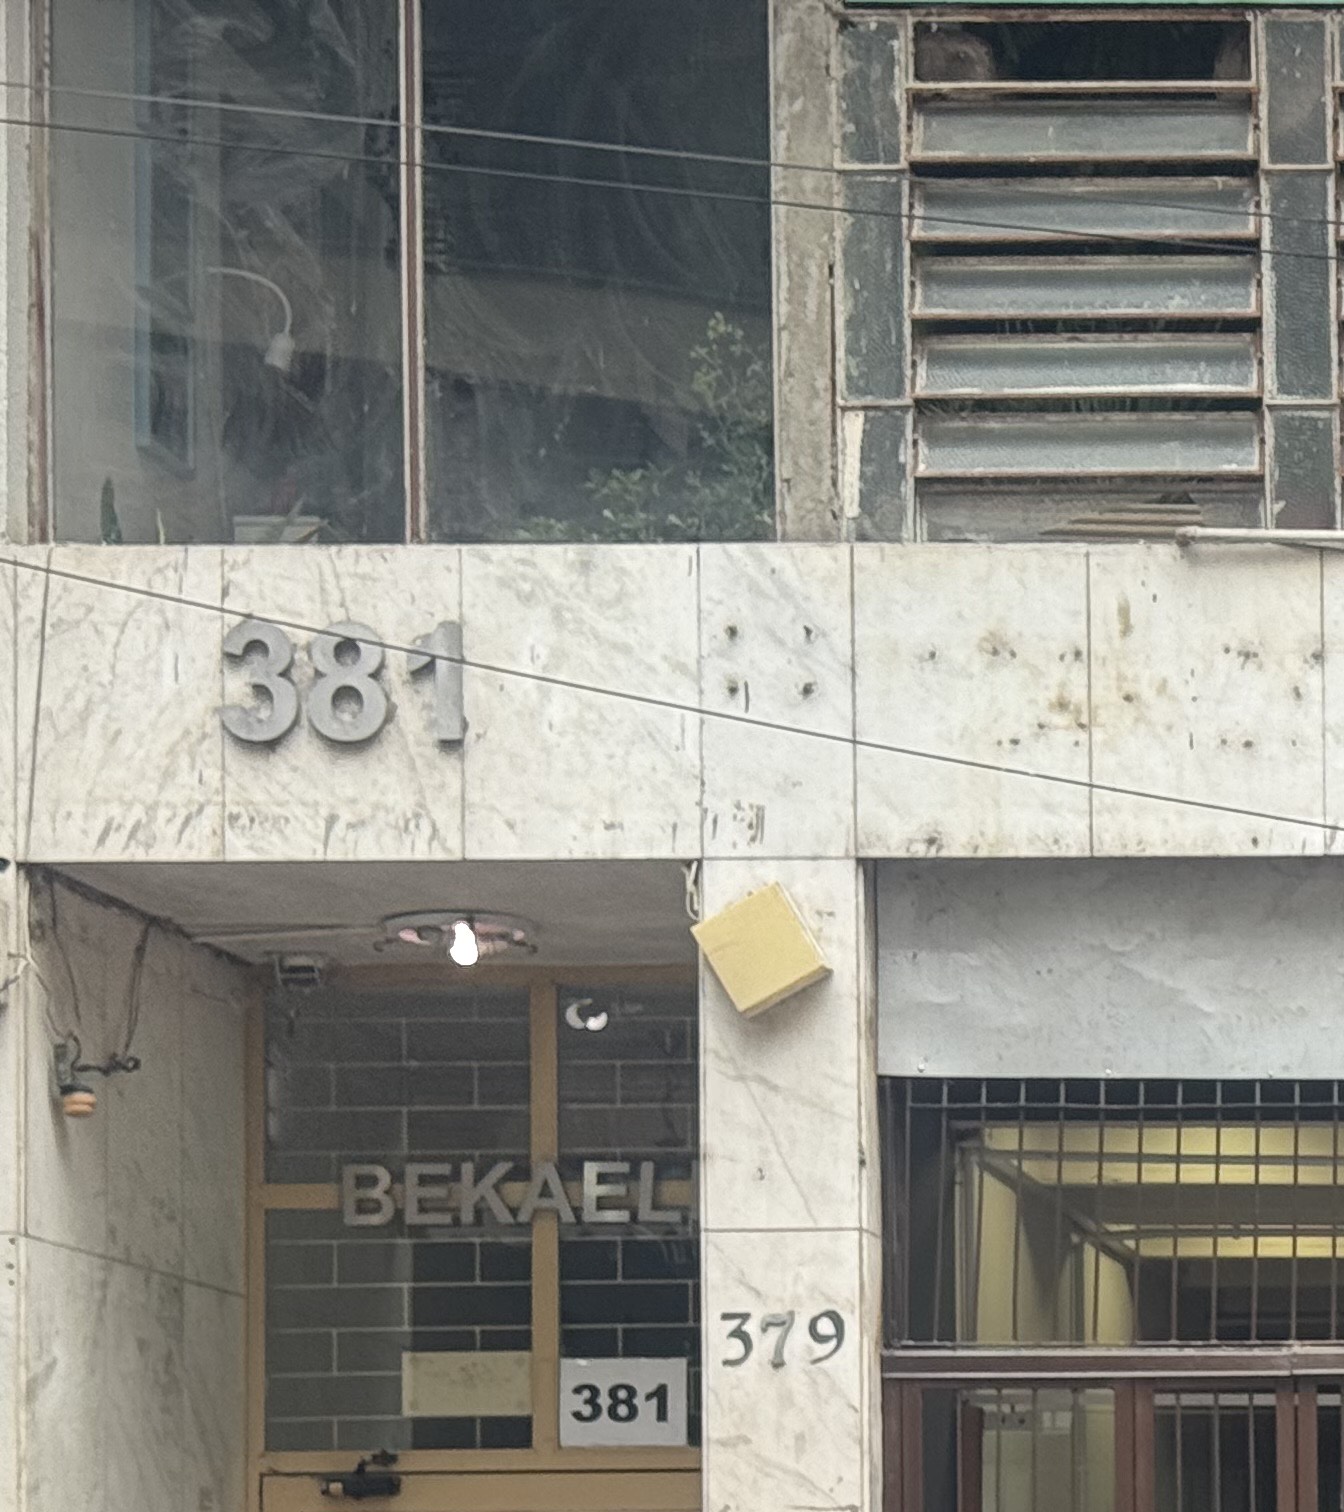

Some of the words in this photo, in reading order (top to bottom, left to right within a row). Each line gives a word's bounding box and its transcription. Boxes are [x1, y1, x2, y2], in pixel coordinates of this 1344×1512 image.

[222, 619, 464, 743] 381
[341, 1159, 700, 1228] BEKAEL
[719, 1309, 846, 1370] 379
[570, 1383, 669, 1424] 381
